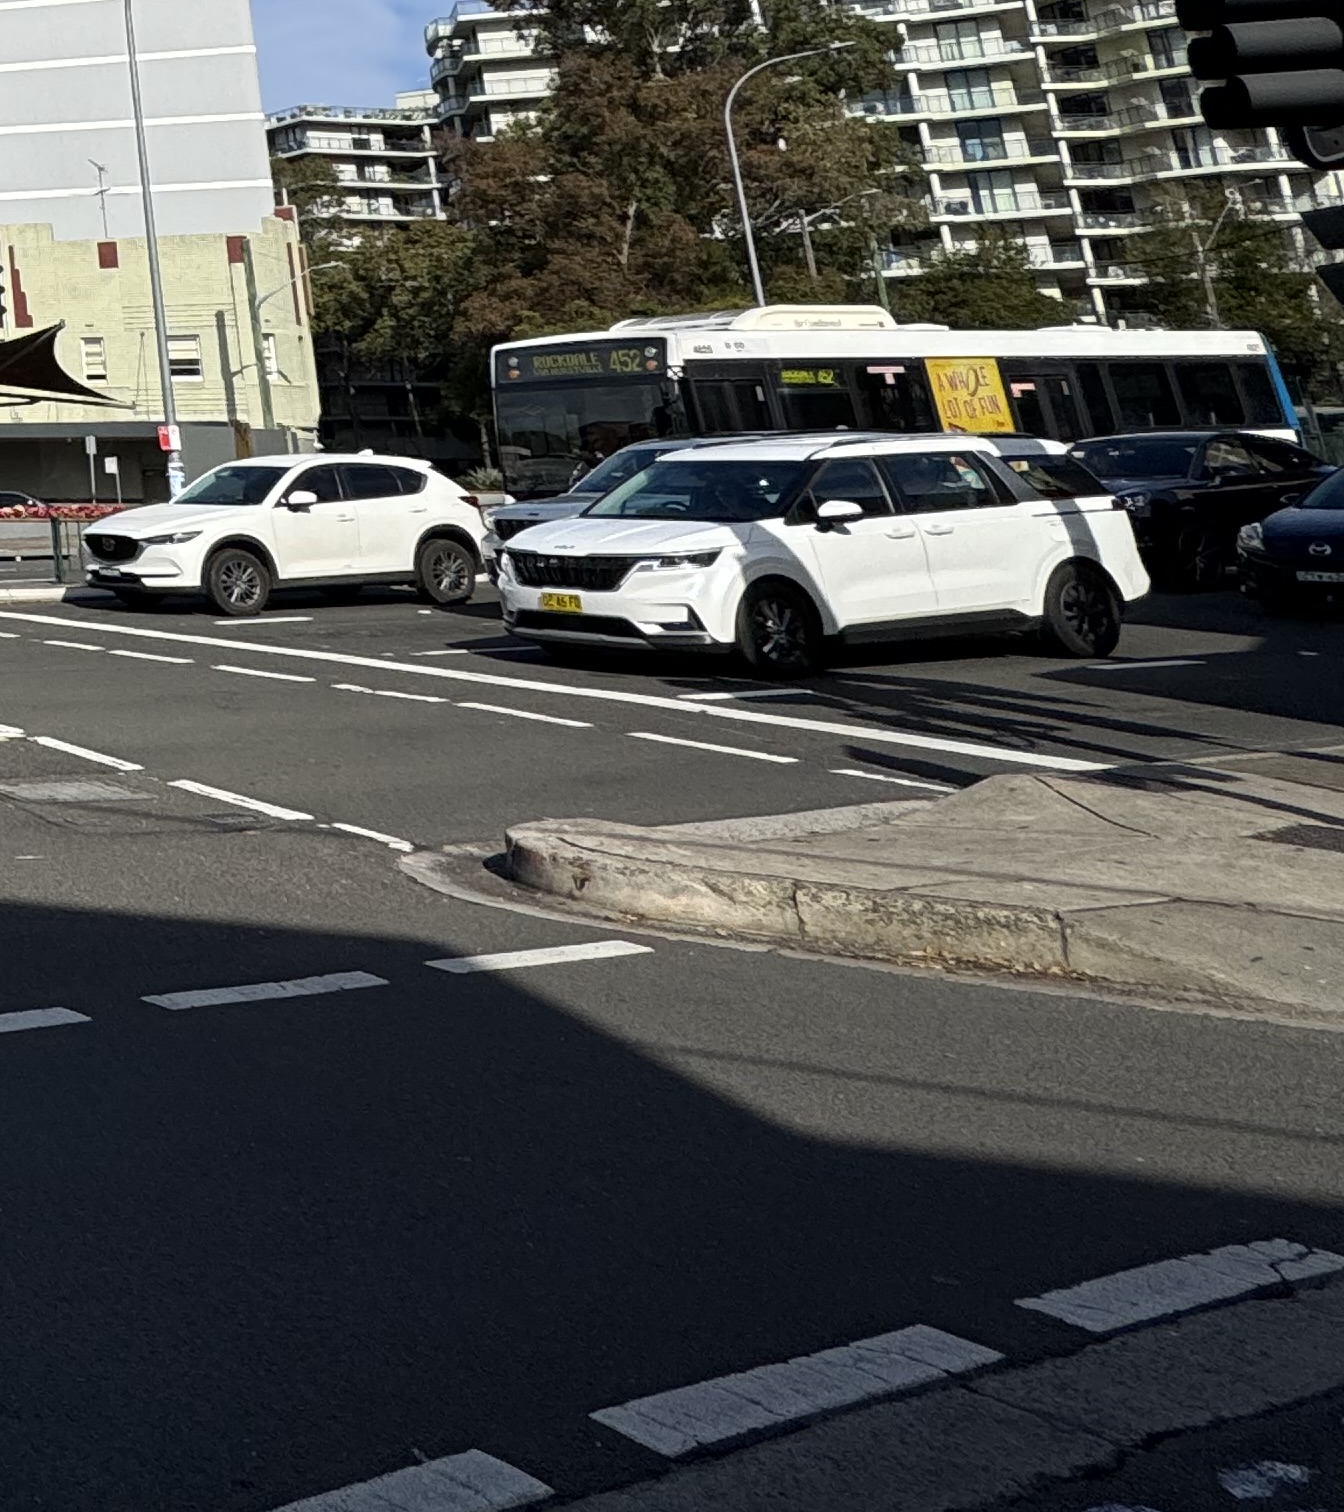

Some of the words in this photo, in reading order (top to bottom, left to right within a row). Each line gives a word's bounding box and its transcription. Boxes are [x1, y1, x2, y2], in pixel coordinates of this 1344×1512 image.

[532, 352, 599, 368] ROCKDALE
[610, 349, 643, 373] 452
[936, 372, 946, 392] A
[942, 397, 962, 419] LOT
[963, 398, 977, 419] OF
[978, 394, 1001, 416] FUN
